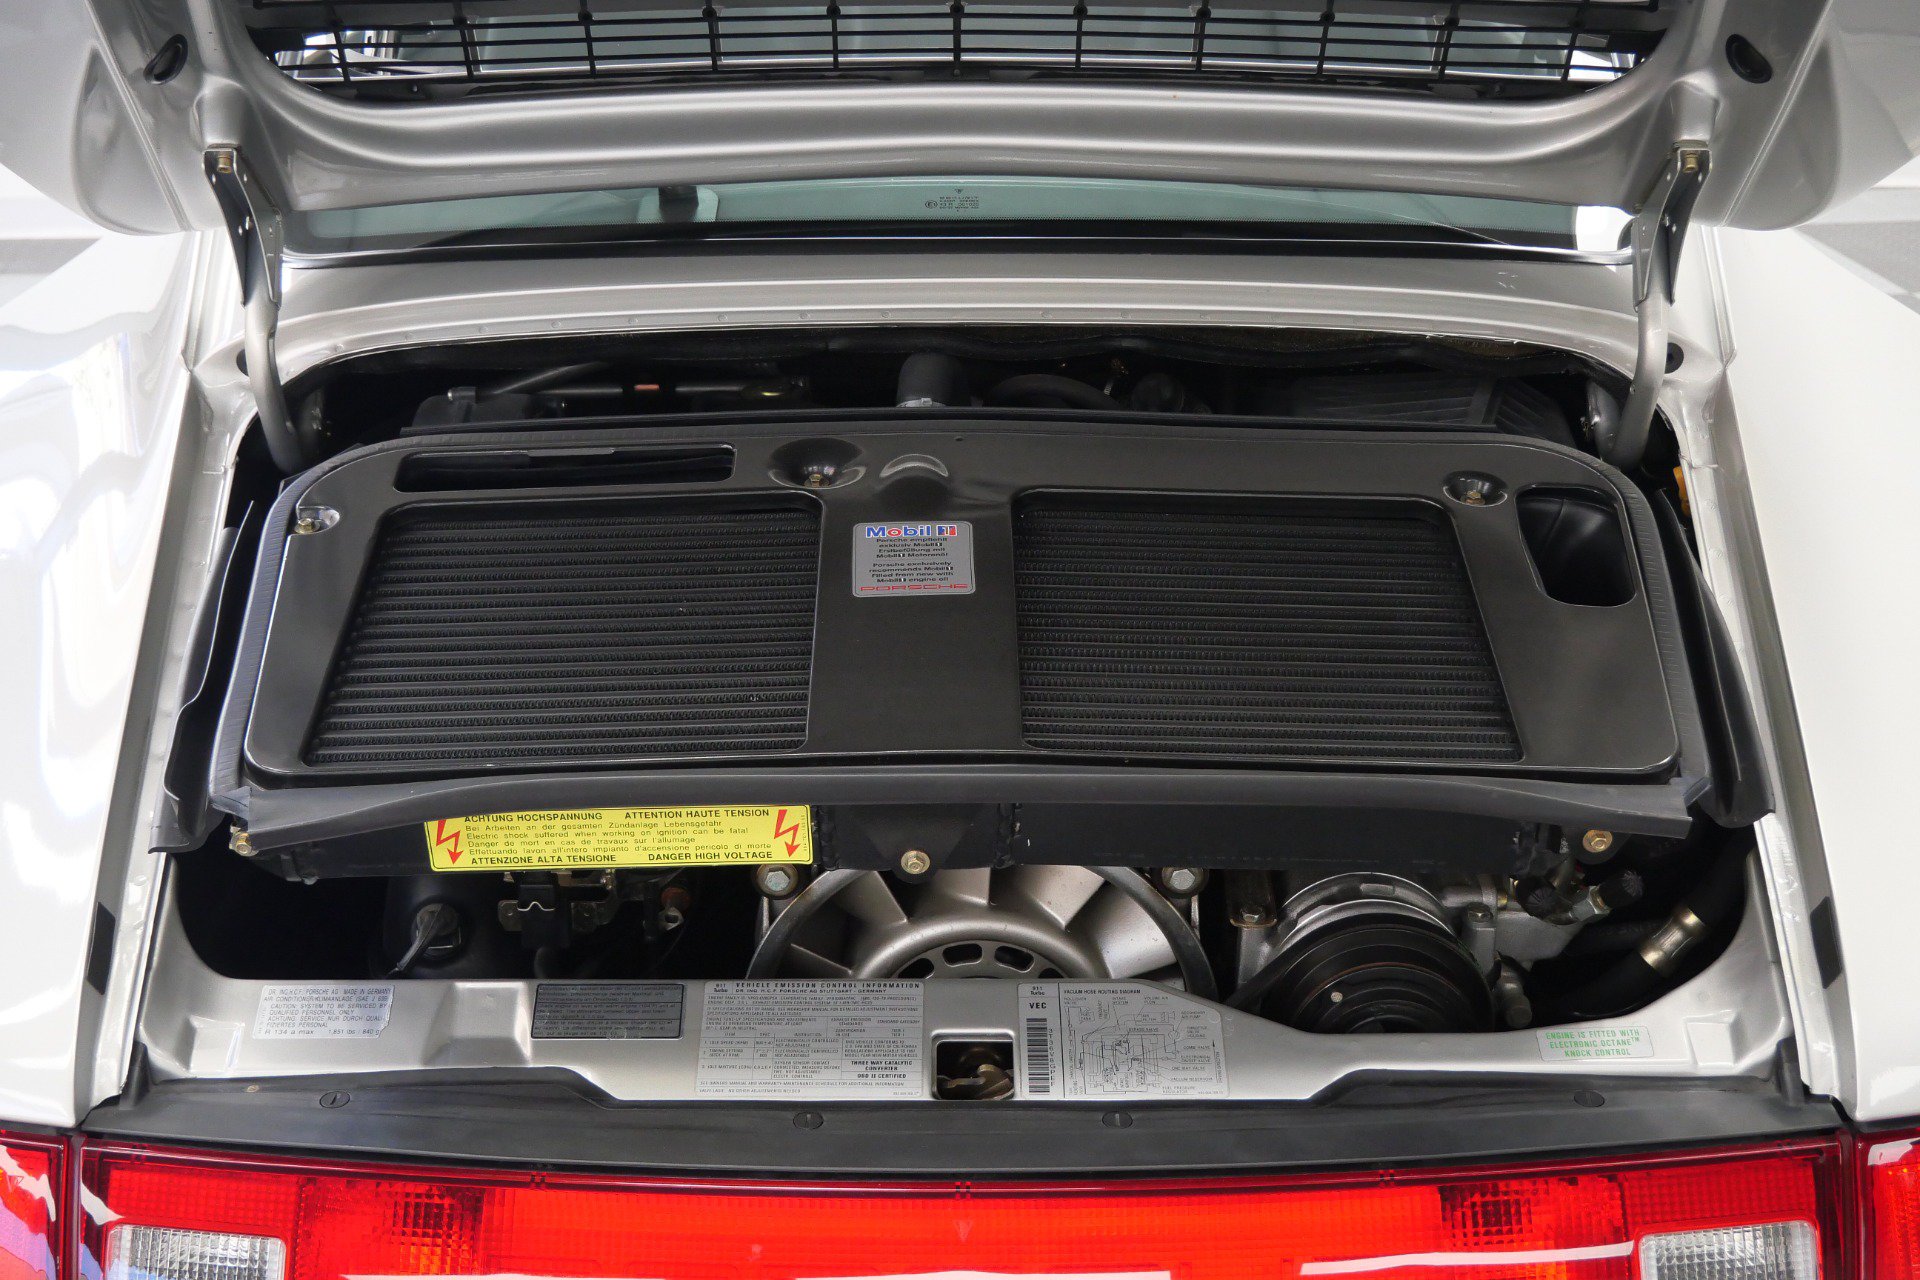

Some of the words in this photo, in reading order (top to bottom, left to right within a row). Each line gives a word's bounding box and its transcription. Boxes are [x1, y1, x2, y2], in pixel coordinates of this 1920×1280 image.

[866, 525, 931, 538] Mobil
[464, 814, 513, 823] ACHTUNG
[517, 812, 602, 822] HOCHSPANNUNG
[625, 811, 682, 820] ATTENTION
[686, 810, 720, 818] HAUTE
[724, 809, 770, 817] TENSION
[656, 828, 688, 836] ignition
[468, 840, 499, 849] Danger
[652, 837, 696, 845] l'allumage
[593, 845, 630, 854] impianto
[695, 844, 729, 852] pericolo
[472, 856, 534, 865] ATTENZIONE
[537, 856, 563, 864] ALTA
[566, 855, 616, 863] TENSIONE
[648, 853, 692, 861] DANGER
[724, 851, 773, 860] VOLTAGE
[1549, 1040, 1598, 1049] ELECTRONIC
[1595, 1048, 1632, 1056] CONTROL
